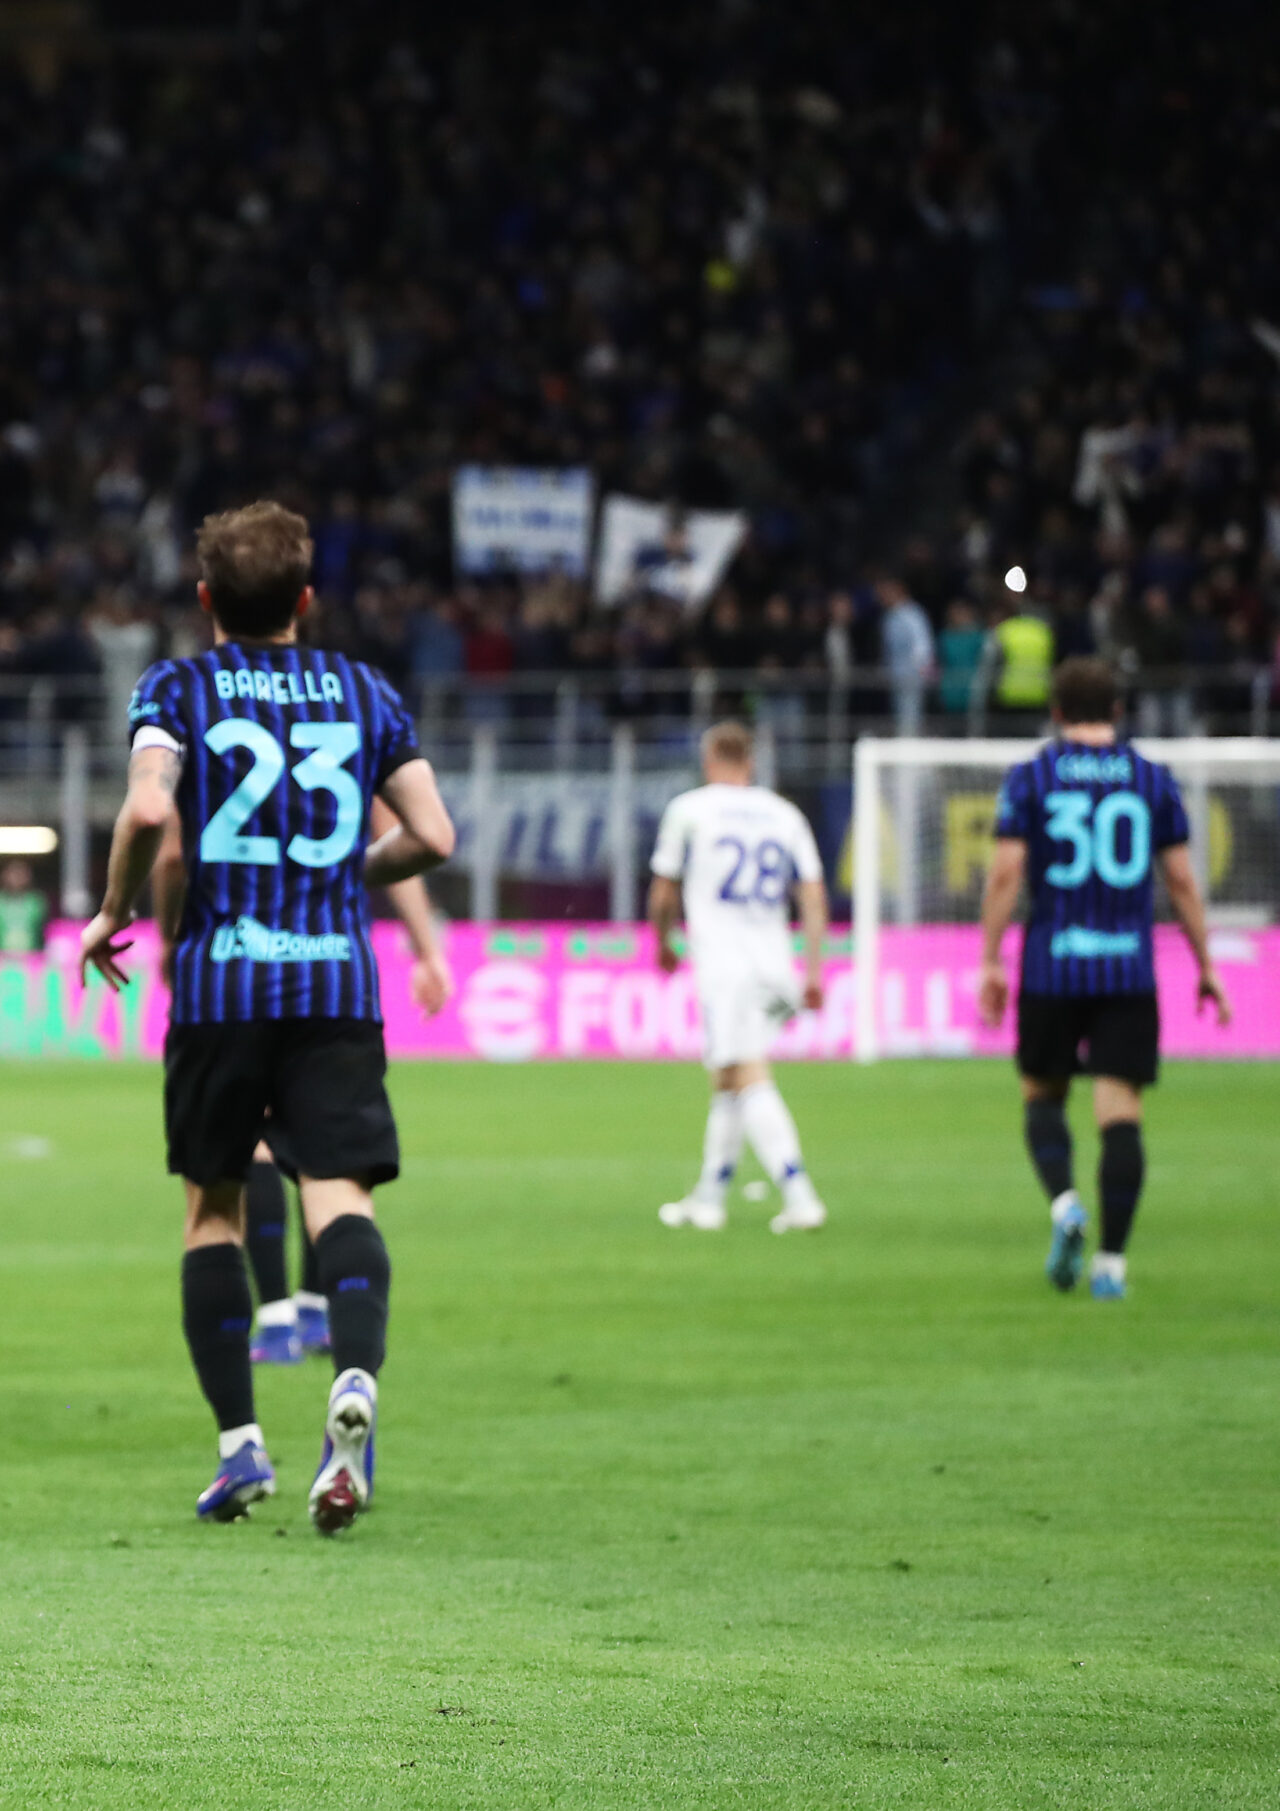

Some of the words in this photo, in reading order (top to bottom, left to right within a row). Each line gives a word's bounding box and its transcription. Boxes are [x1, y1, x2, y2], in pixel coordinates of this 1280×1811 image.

[214, 668, 344, 705] BARELLA
[200, 717, 363, 868] 23
[715, 836, 788, 906] 28
[1044, 790, 1151, 889] 30
